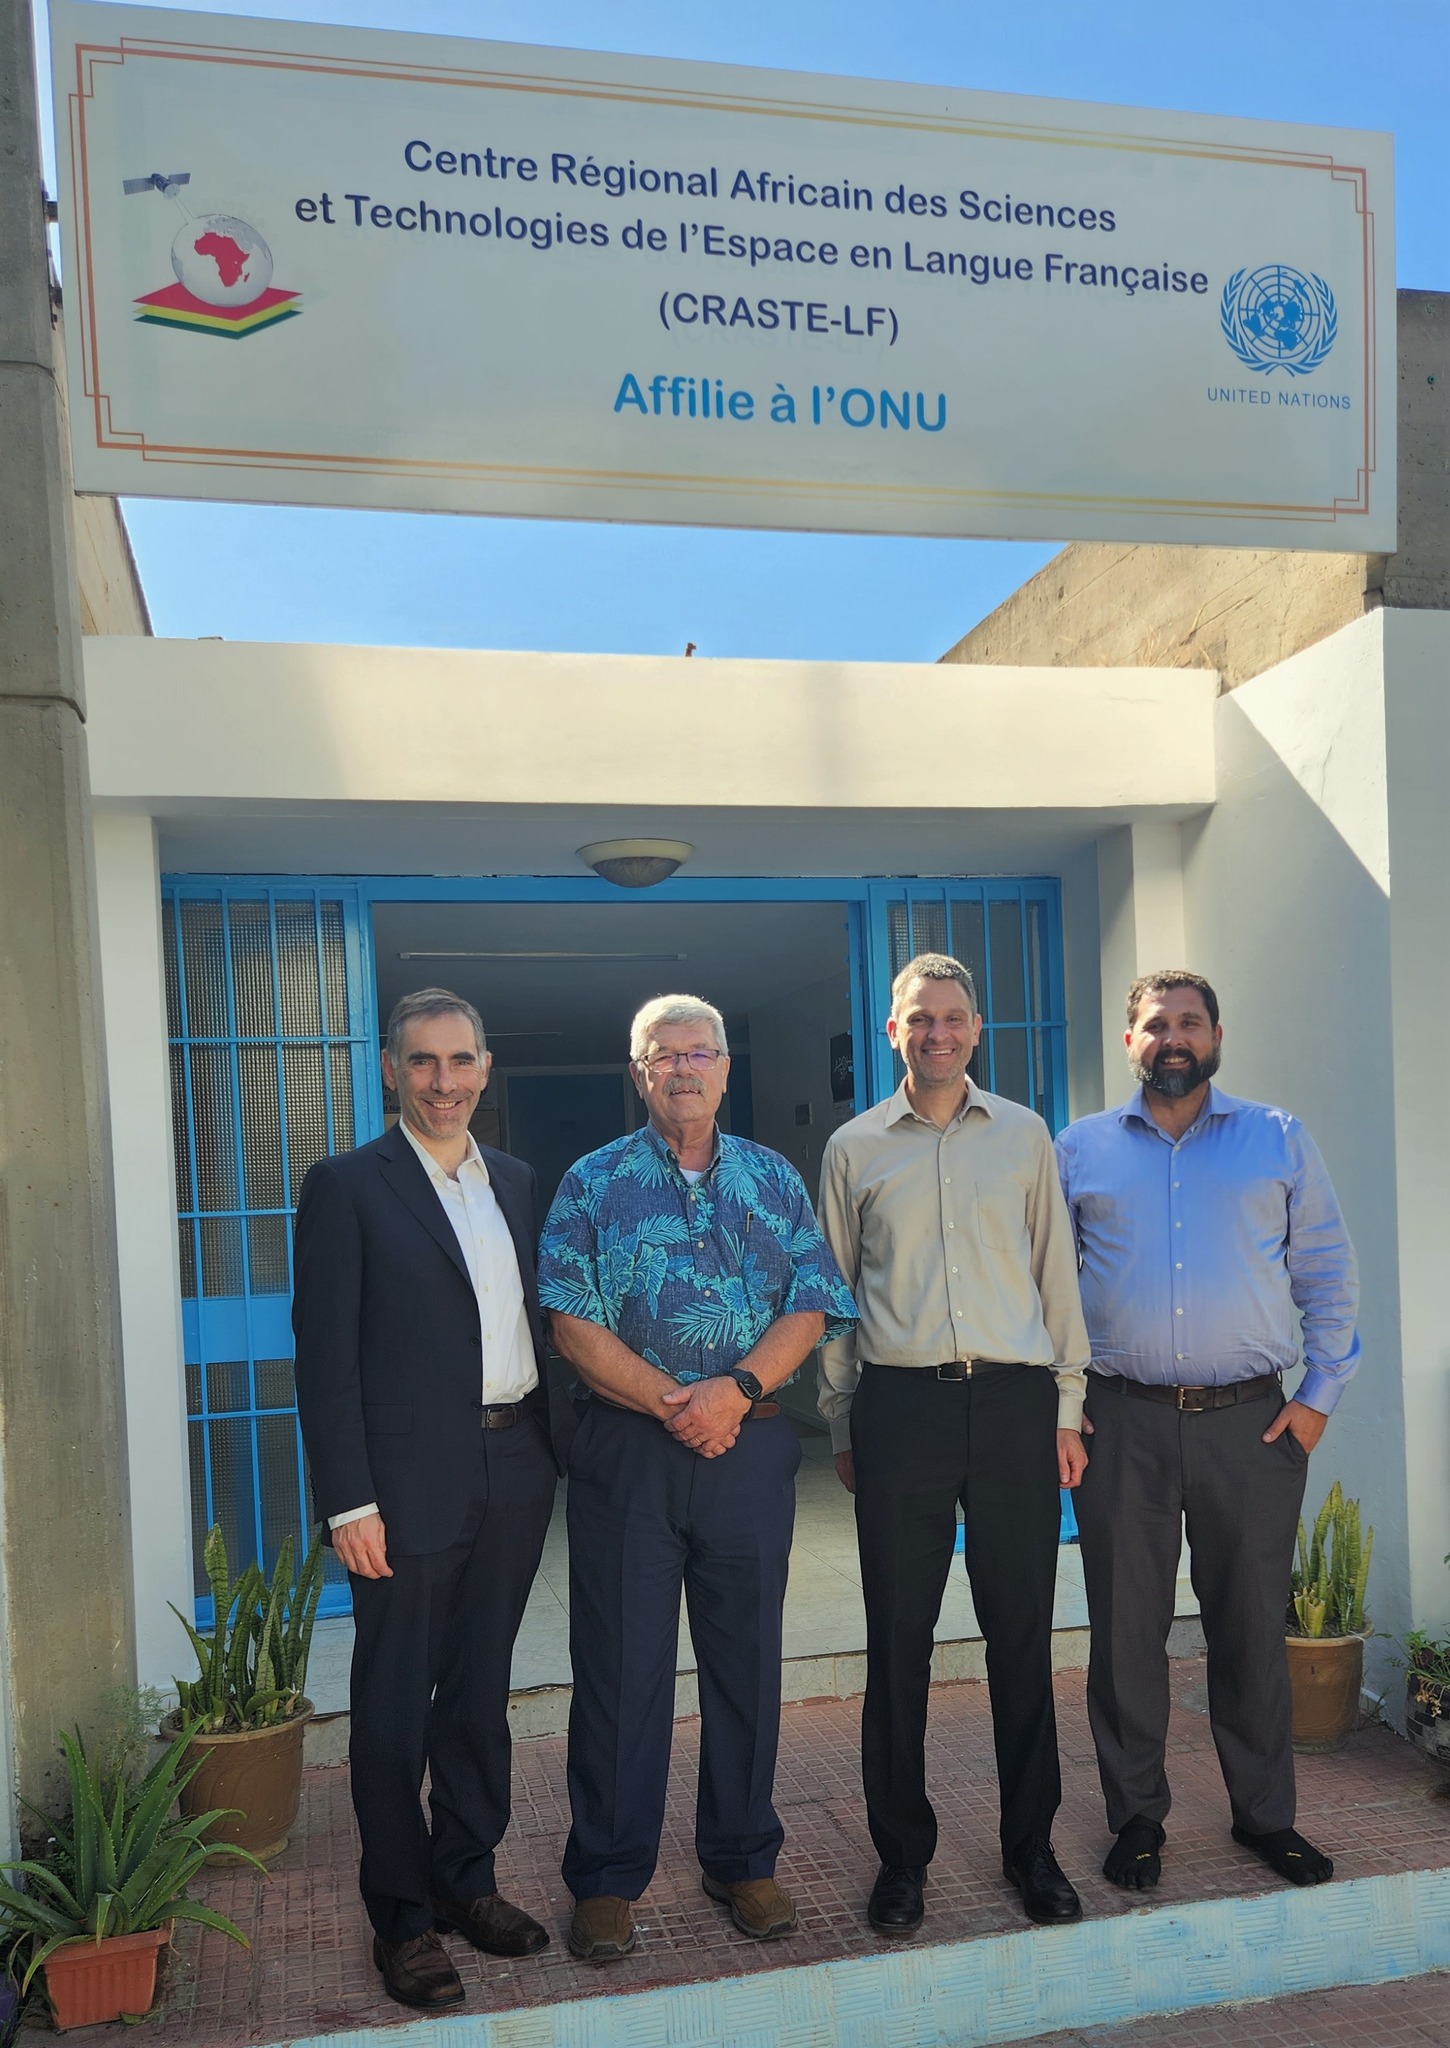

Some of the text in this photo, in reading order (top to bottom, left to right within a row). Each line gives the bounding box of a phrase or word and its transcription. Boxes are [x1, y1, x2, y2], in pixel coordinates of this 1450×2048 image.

[404, 139, 1117, 233] Centre Régional Africain des Sciences
[294, 192, 1209, 297] et Technologies de l'Espace en Langue Française
[659, 290, 899, 347] (CRASTE-LF)
[613, 372, 947, 433] Affilie à l'ONU
[1207, 387, 1351, 410] UNITED NATIONS
